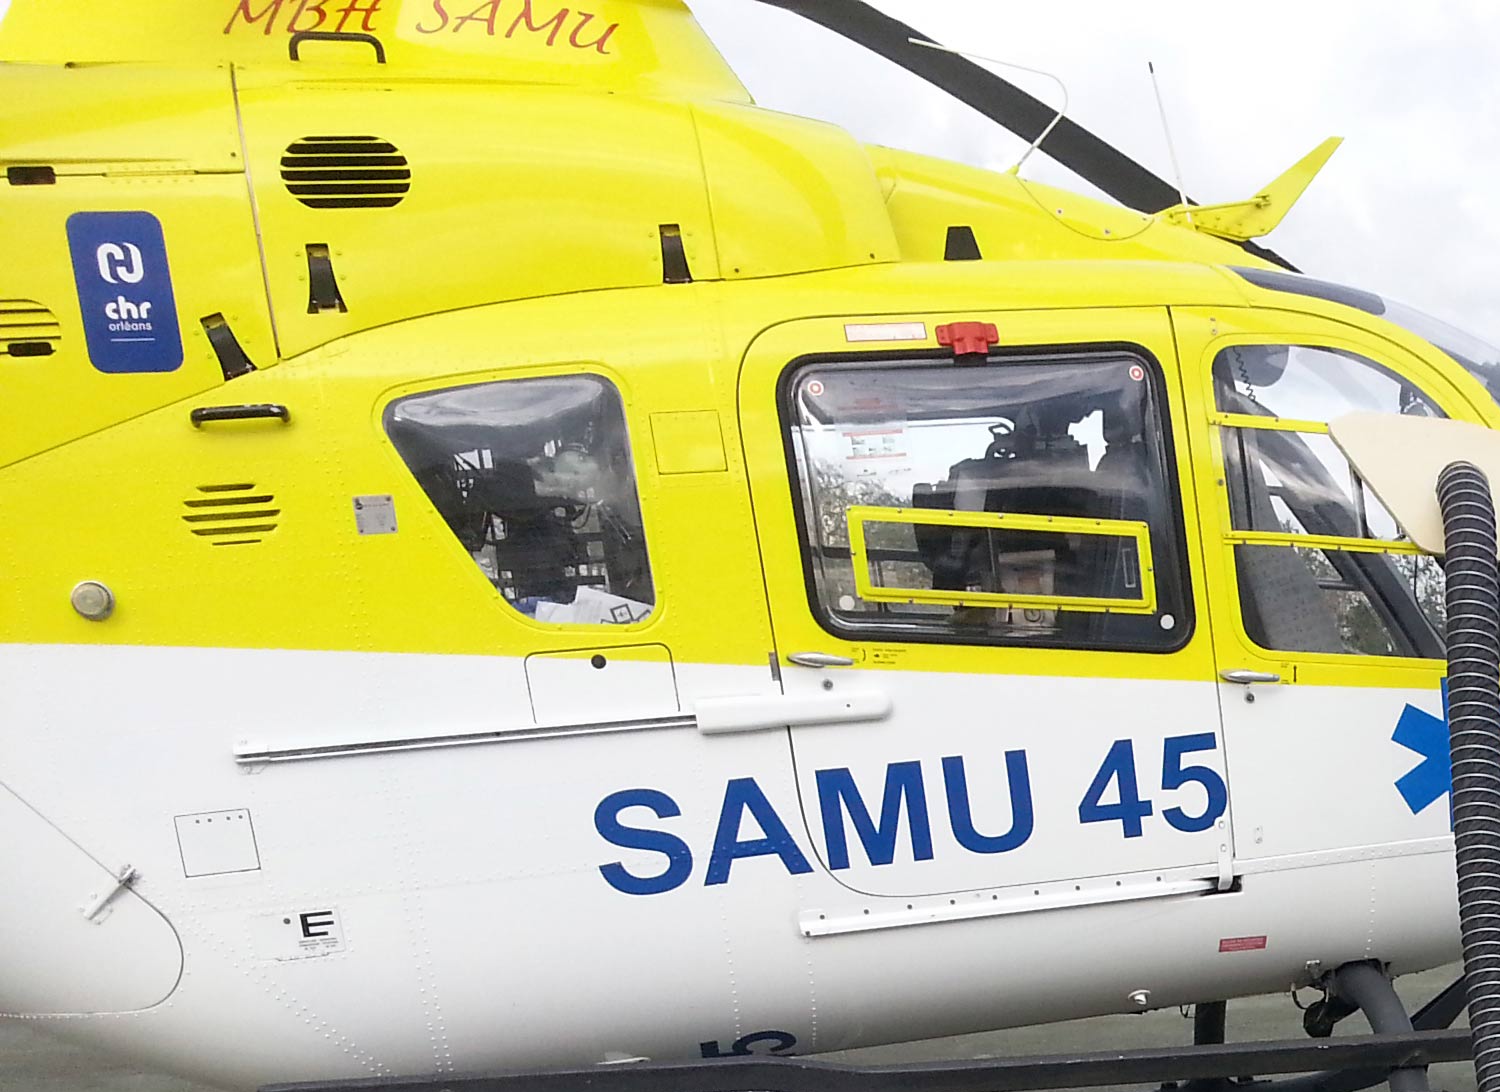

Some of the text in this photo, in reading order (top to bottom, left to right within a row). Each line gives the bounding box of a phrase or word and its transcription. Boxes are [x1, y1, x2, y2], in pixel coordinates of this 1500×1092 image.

[223, 0, 620, 54] MBH SAMU
[105, 296, 152, 320] chr
[593, 732, 1228, 896] SAMU 45
[300, 910, 334, 938] E
